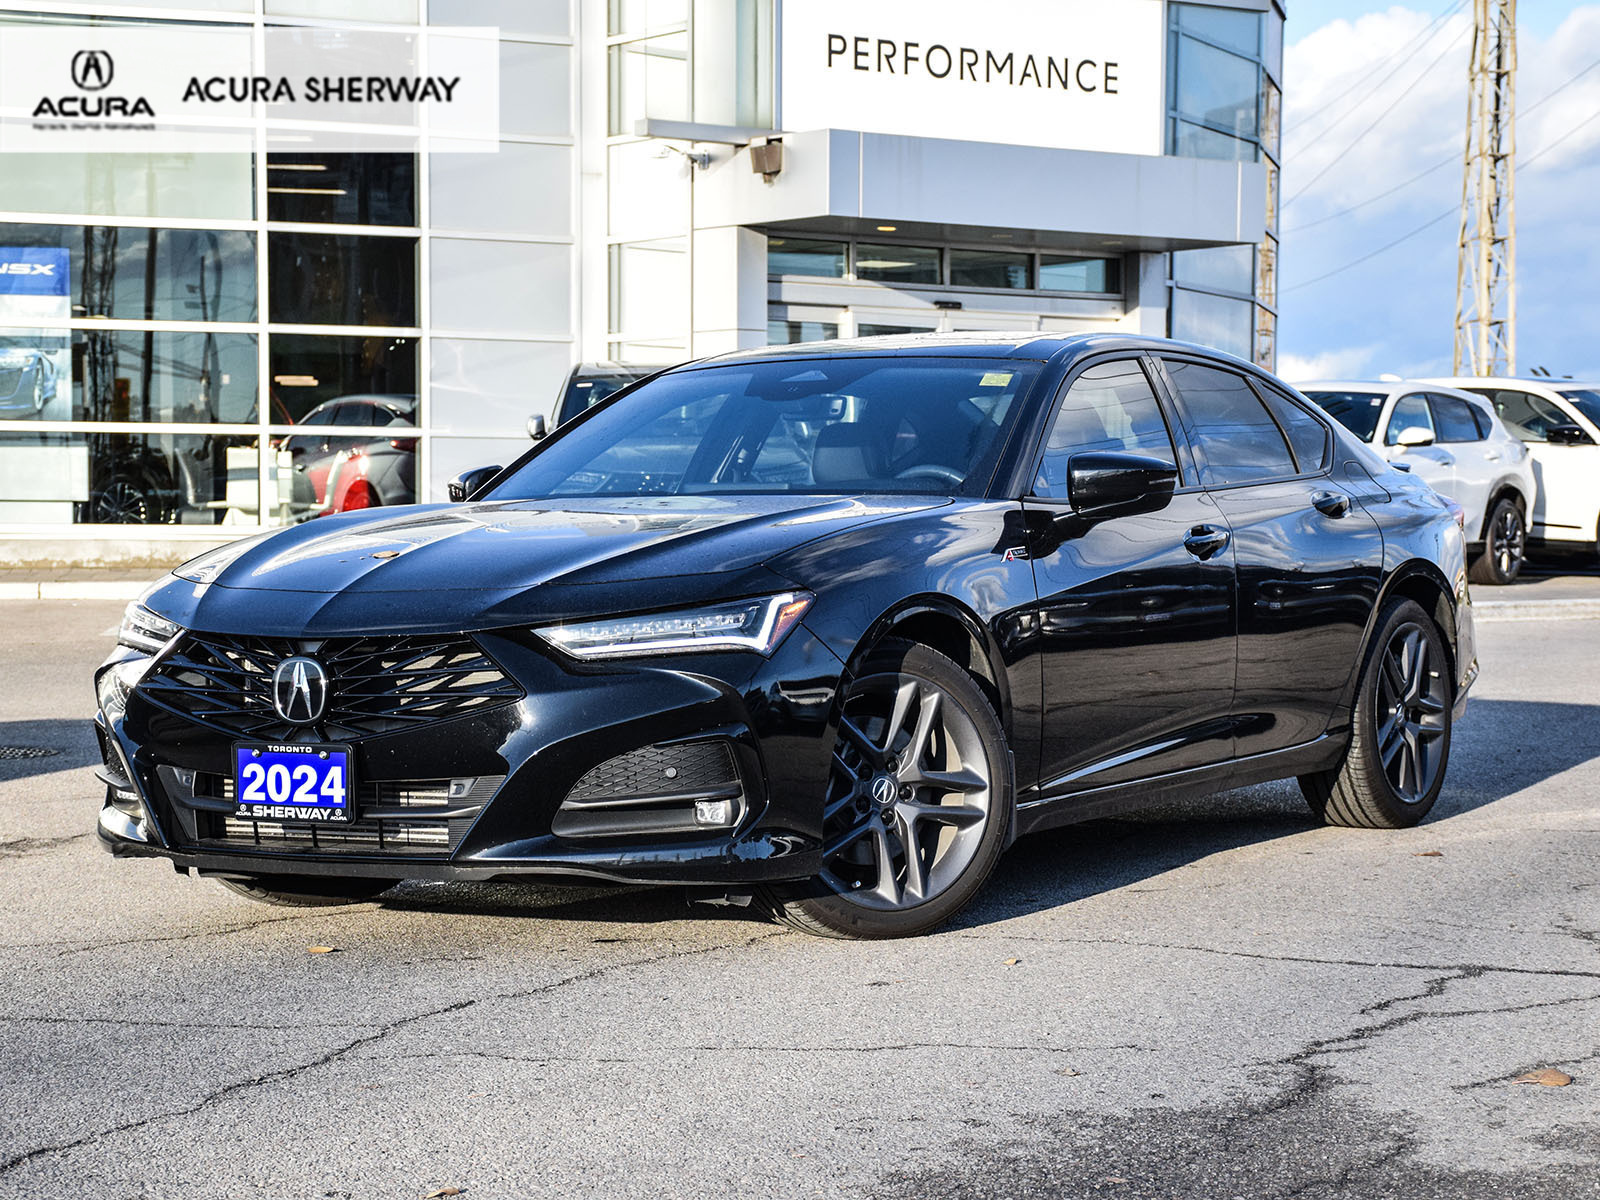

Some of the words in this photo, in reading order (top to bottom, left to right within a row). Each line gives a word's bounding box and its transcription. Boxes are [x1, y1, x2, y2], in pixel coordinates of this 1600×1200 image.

[827, 33, 1119, 95] PERFORMANCE
[267, 745, 313, 753] TORONTO
[242, 763, 345, 803] 2024
[252, 805, 332, 820] SHERWAY
